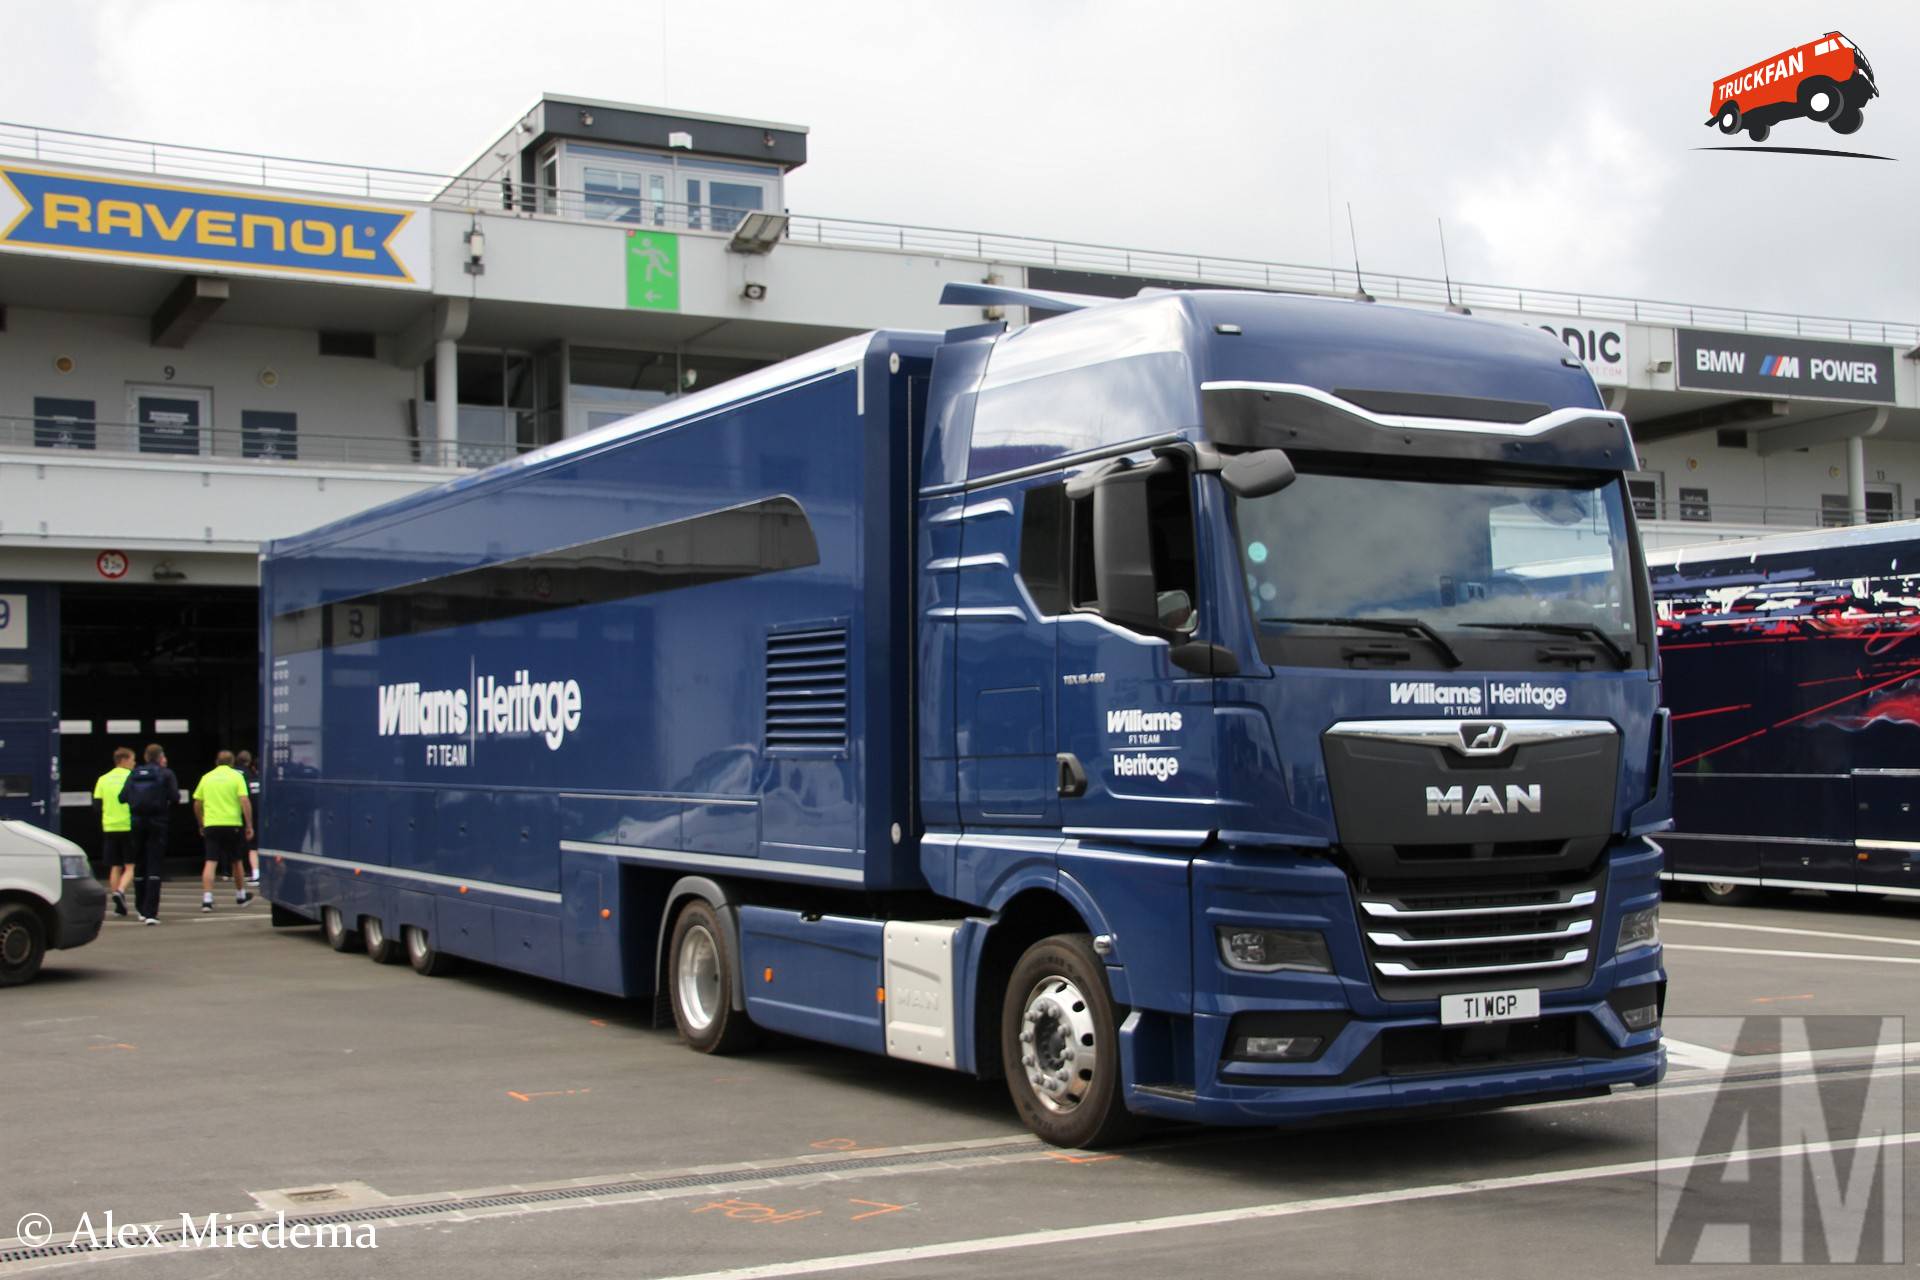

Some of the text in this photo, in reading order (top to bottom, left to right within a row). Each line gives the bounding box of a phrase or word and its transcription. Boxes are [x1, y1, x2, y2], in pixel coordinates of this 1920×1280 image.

[164, 365, 176, 381] 9
[1696, 348, 1745, 375] BMW
[1810, 358, 1878, 385] POWER
[1390, 682, 1567, 710] Williams Heritage
[378, 669, 582, 751] Williams Heritage
[1107, 709, 1182, 733] Williams
[1444, 706, 1482, 716] F1 TEAM
[1128, 734, 1161, 744] F1 TEAM
[426, 745, 468, 767] F1 TEAM
[1113, 753, 1179, 782] Heritage
[1426, 784, 1541, 816] MAN
